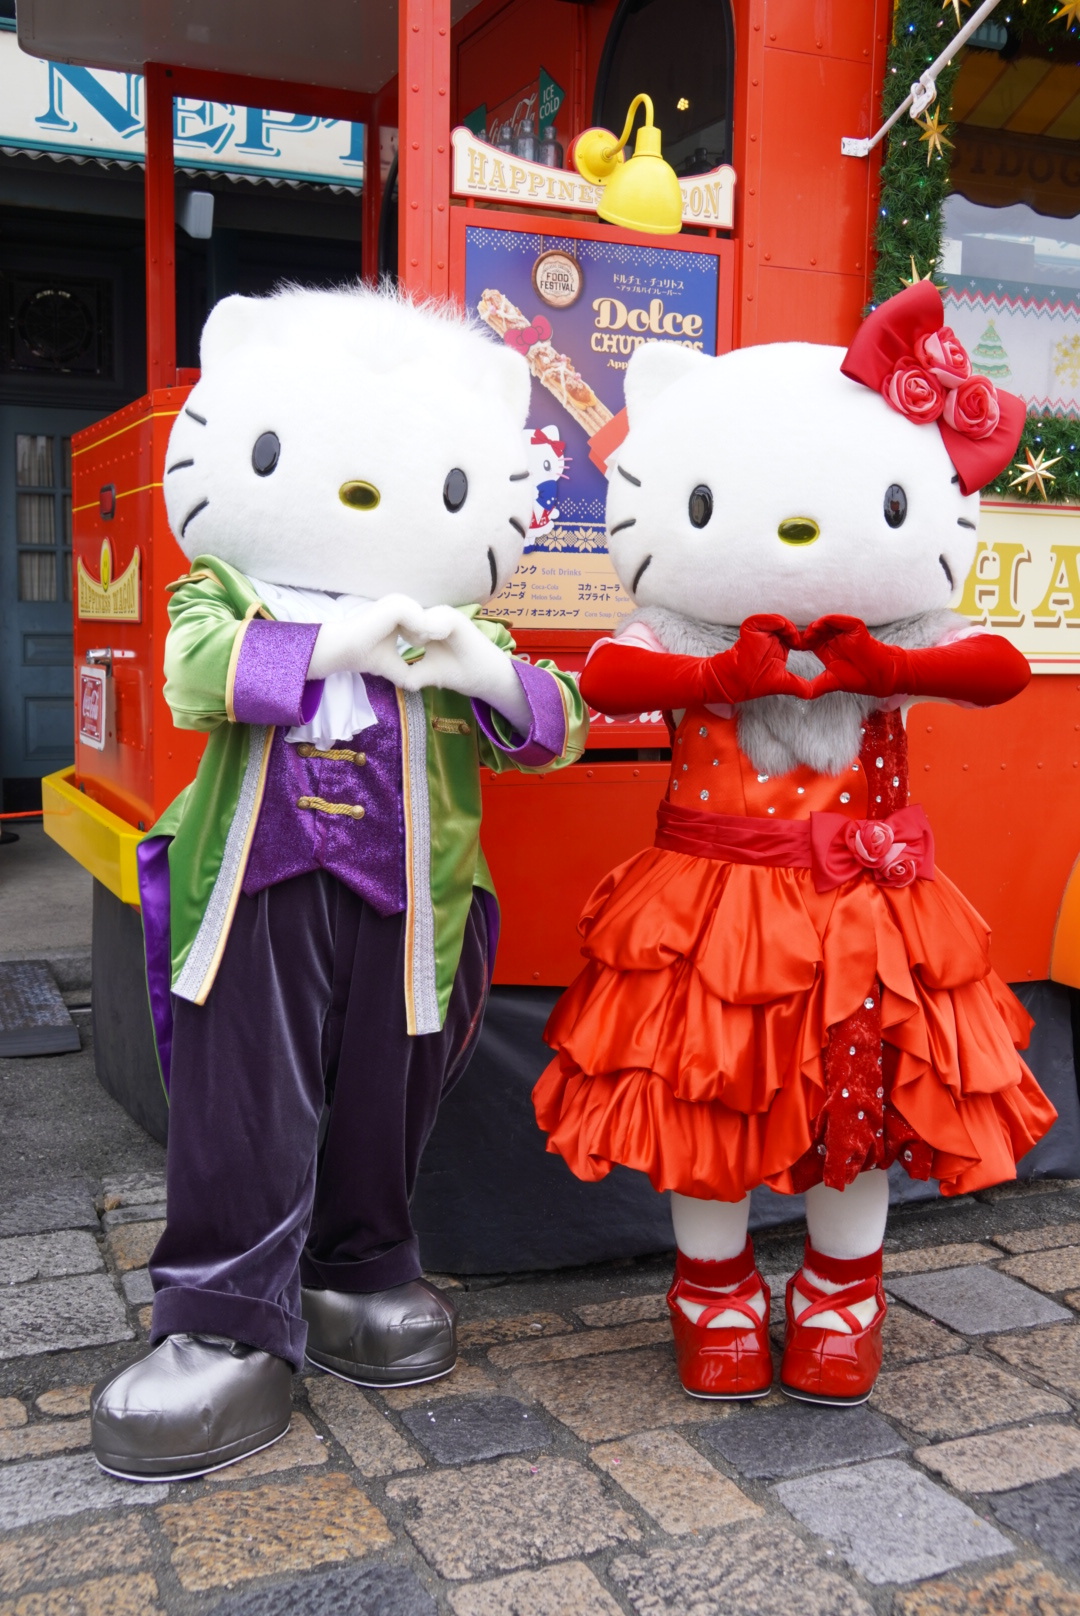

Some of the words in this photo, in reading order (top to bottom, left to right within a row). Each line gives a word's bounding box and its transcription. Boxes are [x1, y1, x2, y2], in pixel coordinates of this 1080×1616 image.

[543, 84, 555, 103] ICE
[540, 96, 560, 120] COLD
[466, 147, 606, 205] HAPPINES
[546, 272, 569, 283] FOOD
[540, 280, 575, 292] FESTIVAL
[592, 297, 703, 337] Dolce
[541, 567, 556, 576] Soft
[558, 568, 582, 577] Drinks
[505, 581, 527, 590] コーラ
[531, 583, 559, 591] Coca-Cola
[578, 583, 621, 592] コカ・コーラ
[578, 593, 611, 602] スプライト
[530, 608, 580, 618] オニオンスープ
[599, 611, 612, 619] Soup
